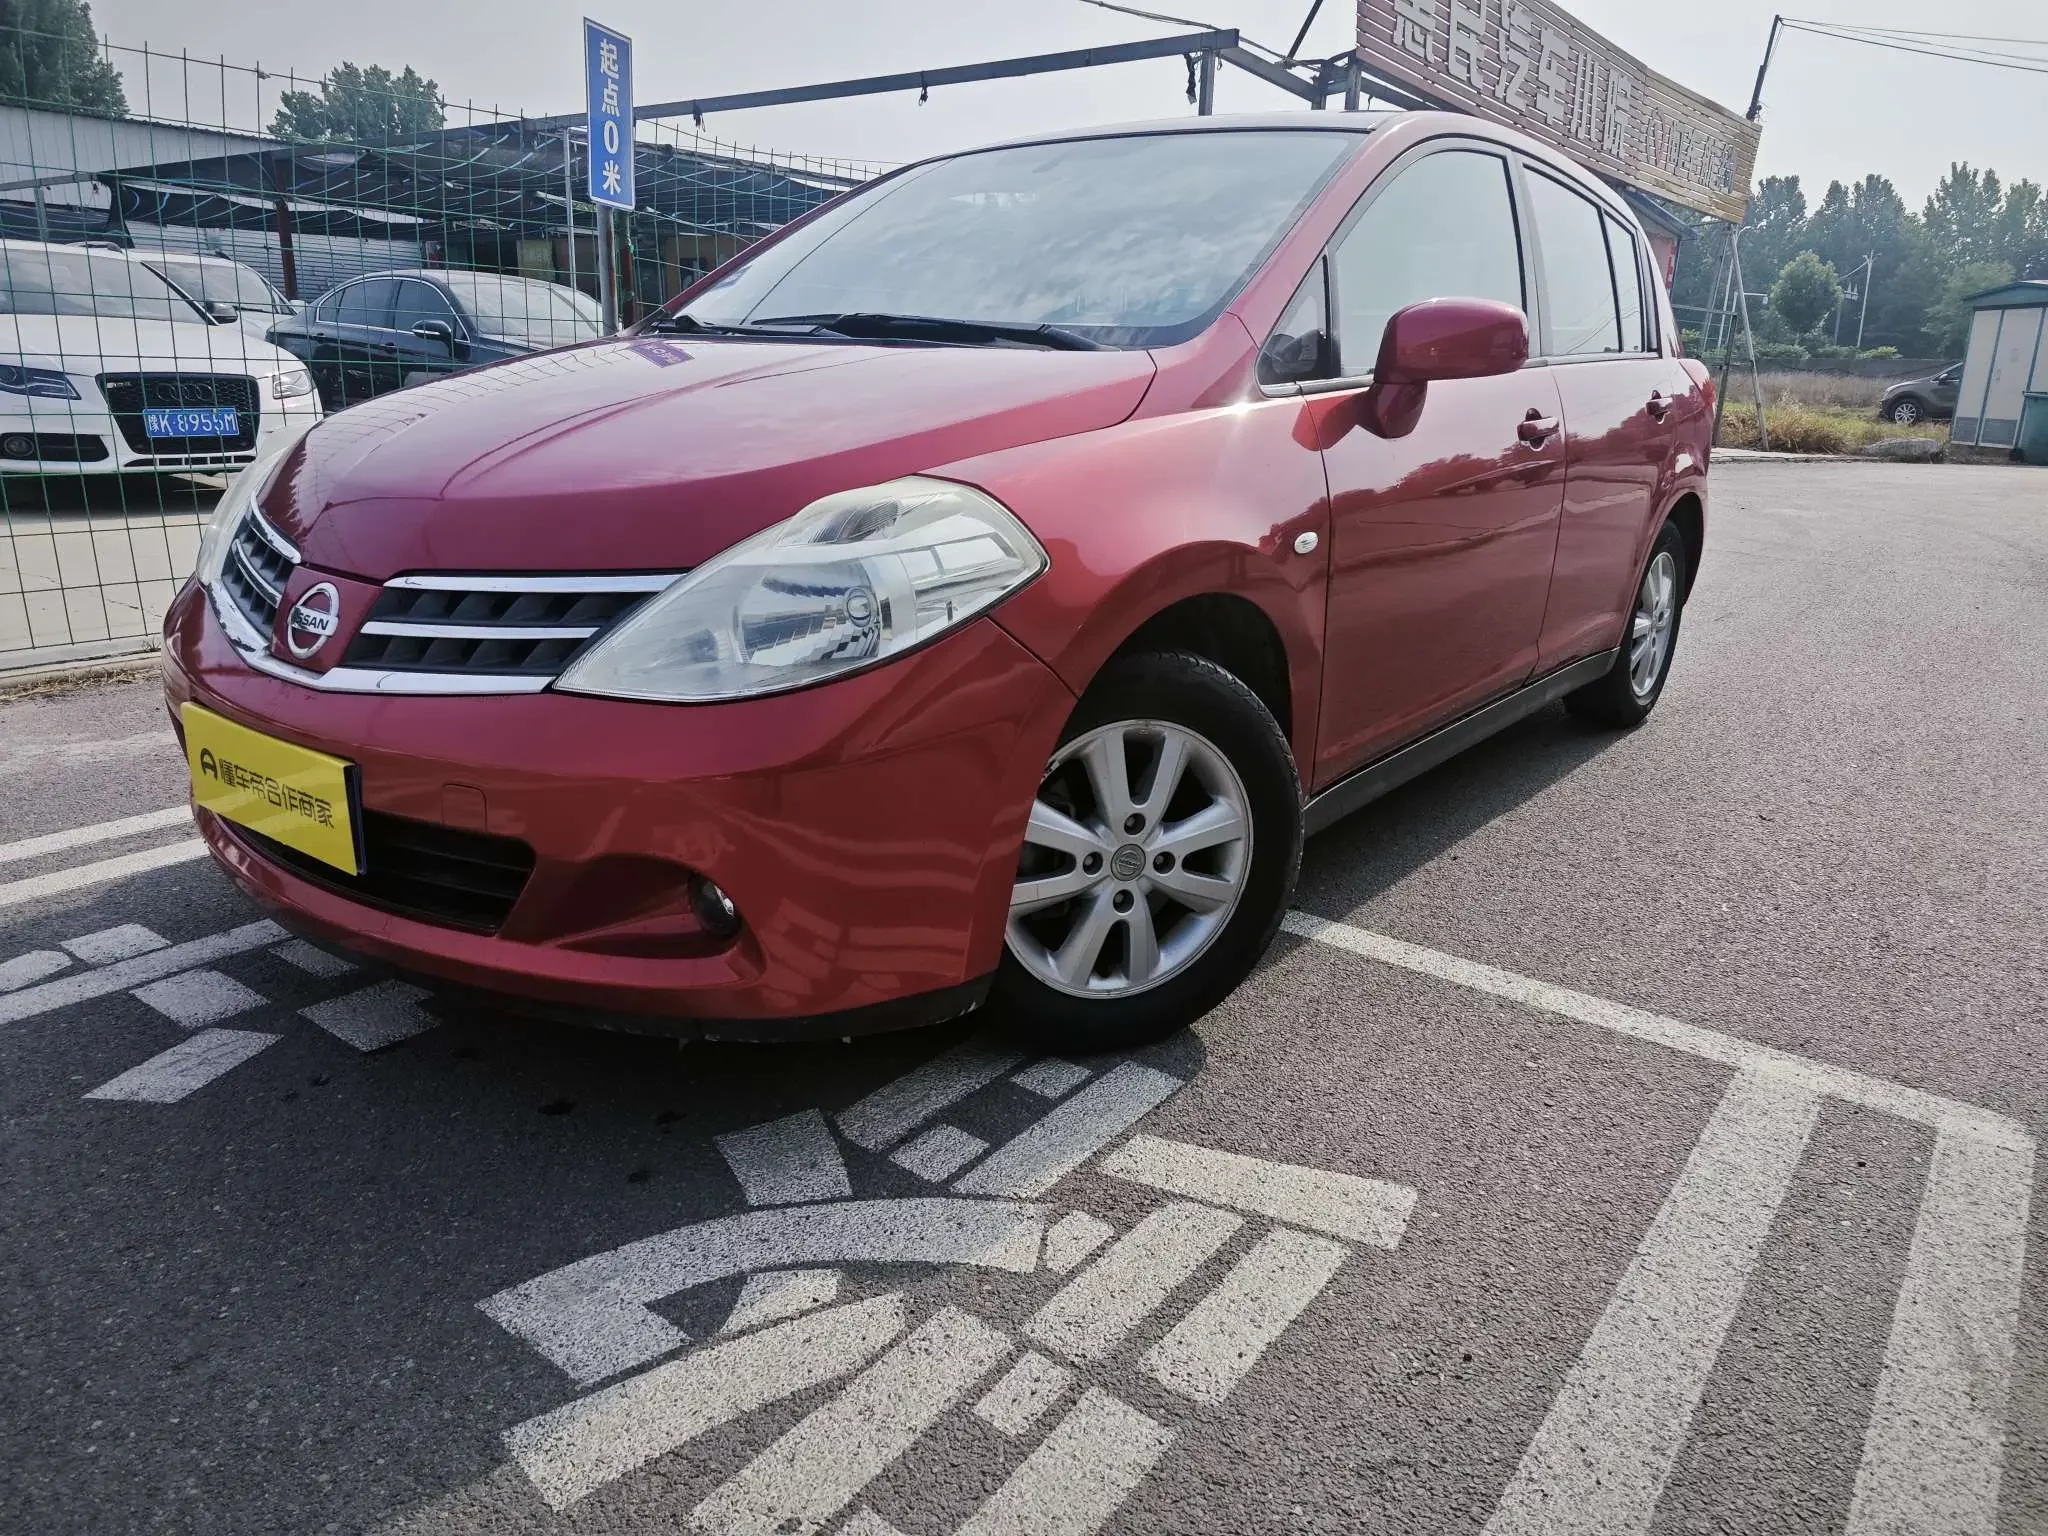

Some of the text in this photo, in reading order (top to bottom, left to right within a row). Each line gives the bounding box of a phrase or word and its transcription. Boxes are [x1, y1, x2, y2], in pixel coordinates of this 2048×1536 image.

[600, 39, 621, 195] 起点0米
[291, 607, 330, 630] SSAN
